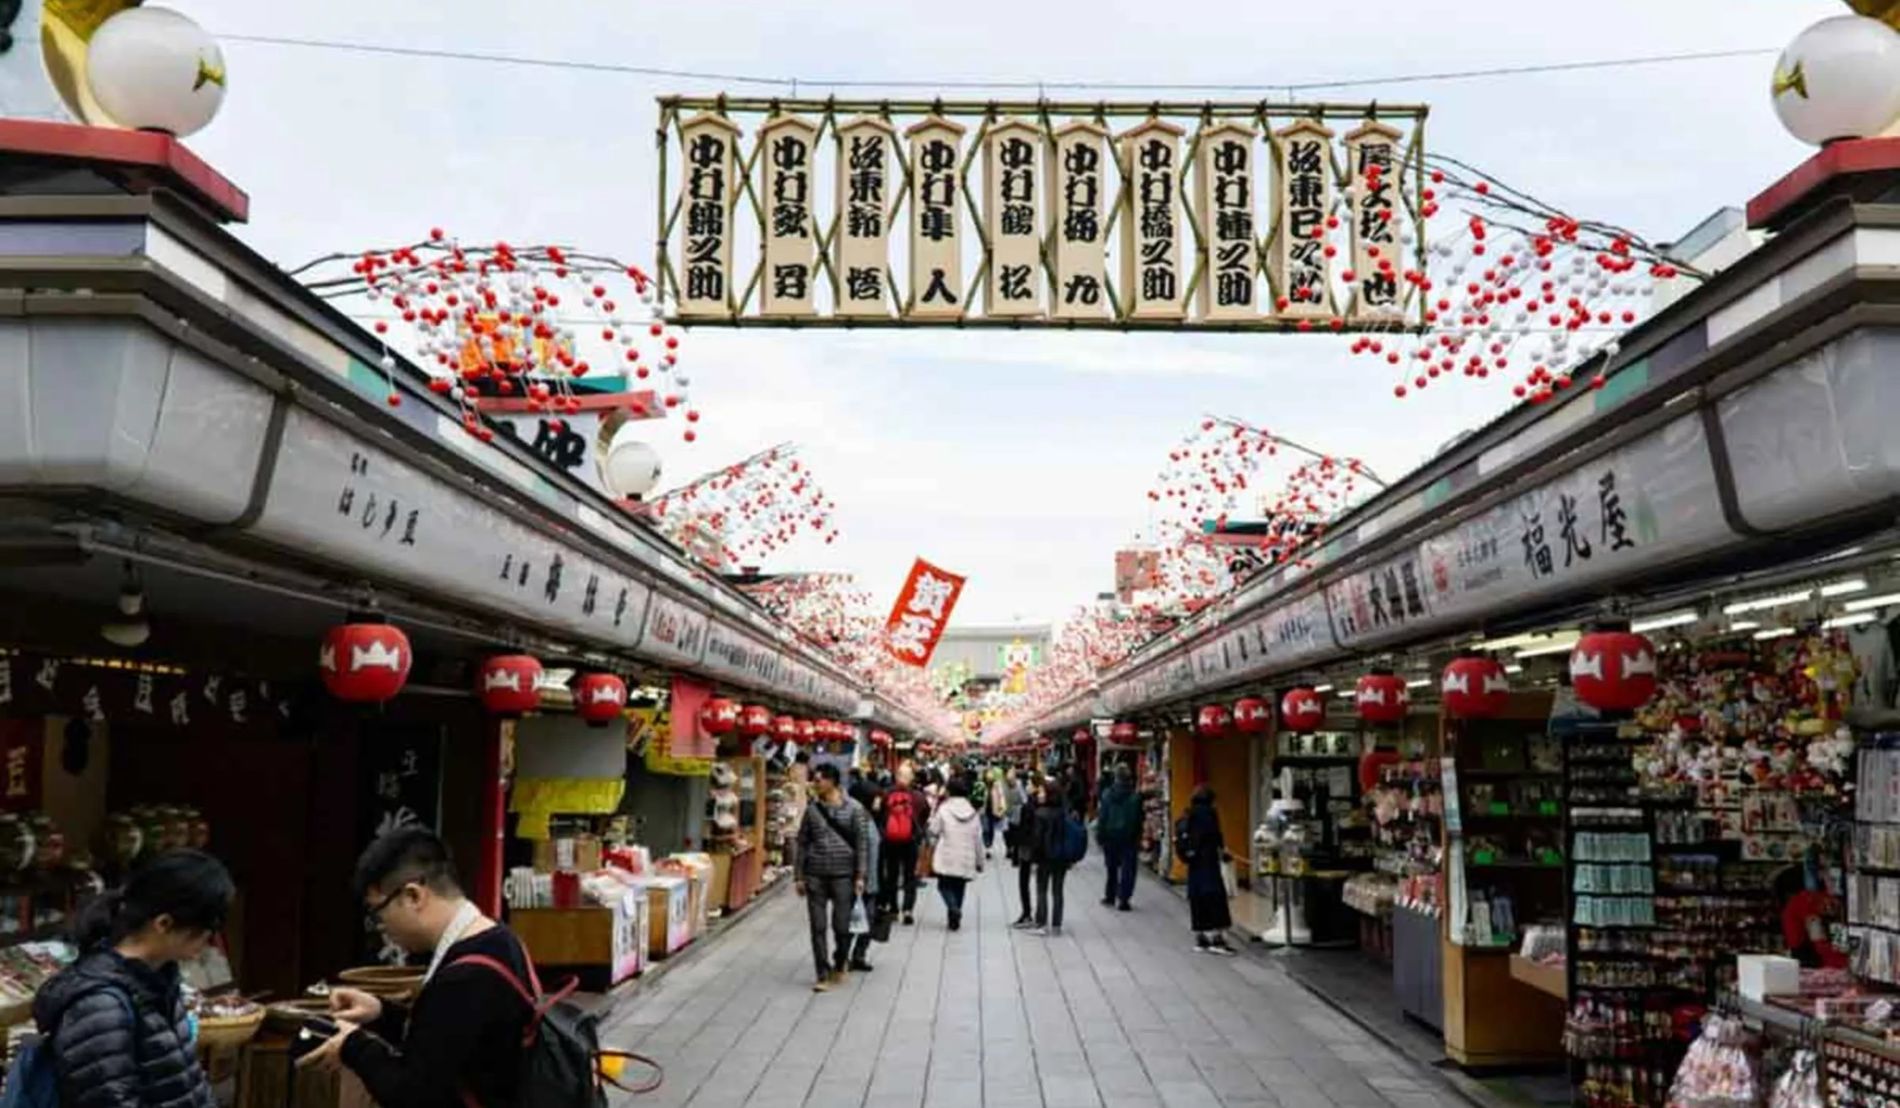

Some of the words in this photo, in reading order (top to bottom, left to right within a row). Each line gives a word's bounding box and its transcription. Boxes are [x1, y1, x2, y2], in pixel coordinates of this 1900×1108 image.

[920, 140, 957, 303] 中村隼人
[999, 137, 1034, 300] 中村鶴松
[1138, 139, 1176, 301] 中村橋之助
[1521, 468, 1635, 580] 福光屋
